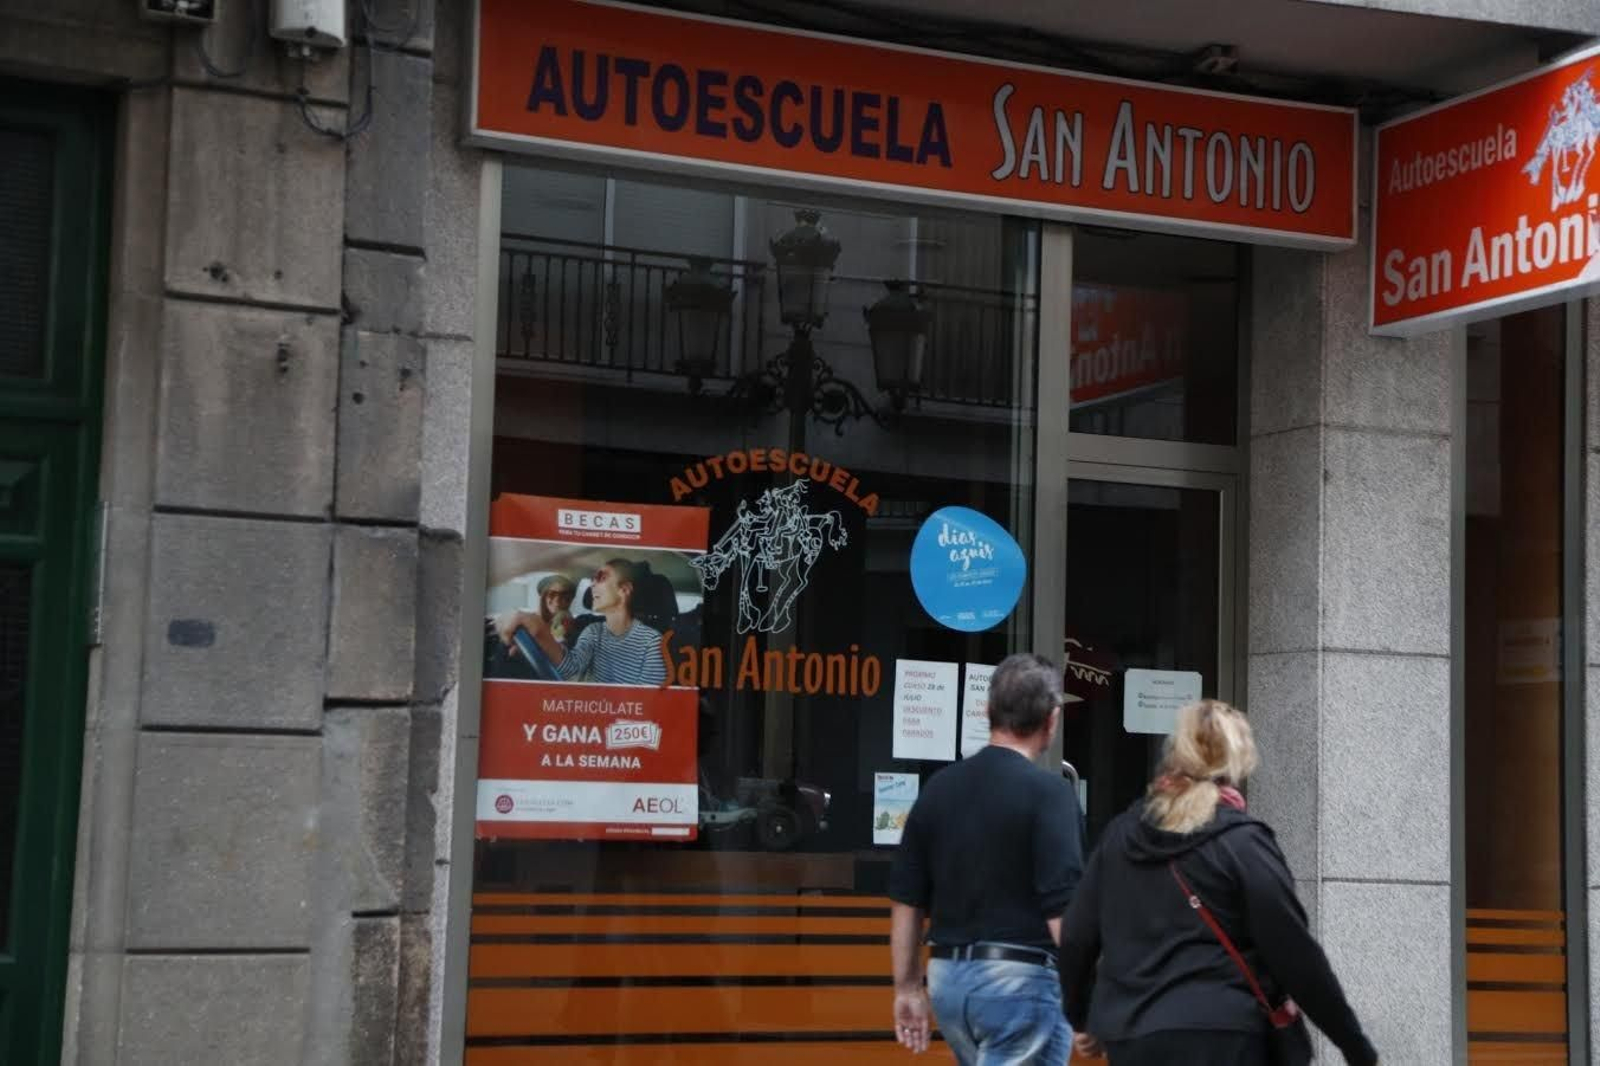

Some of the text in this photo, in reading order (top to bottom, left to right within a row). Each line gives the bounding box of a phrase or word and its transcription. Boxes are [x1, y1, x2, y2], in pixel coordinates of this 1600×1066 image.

[526, 45, 1316, 213] AUTOESCUELA SAN ANTONIO
[1389, 123, 1517, 195] Autoescuela
[1382, 193, 1600, 306] San Antoni
[669, 448, 881, 516] AUTOESCUELA
[564, 513, 635, 530] BECAS
[661, 629, 881, 697] San Antonio
[542, 698, 644, 716] MATRICÚLATE
[523, 724, 649, 744] Y GANA 250€
[541, 754, 641, 769] A LA SEMANA
[632, 796, 683, 814] AEOL
